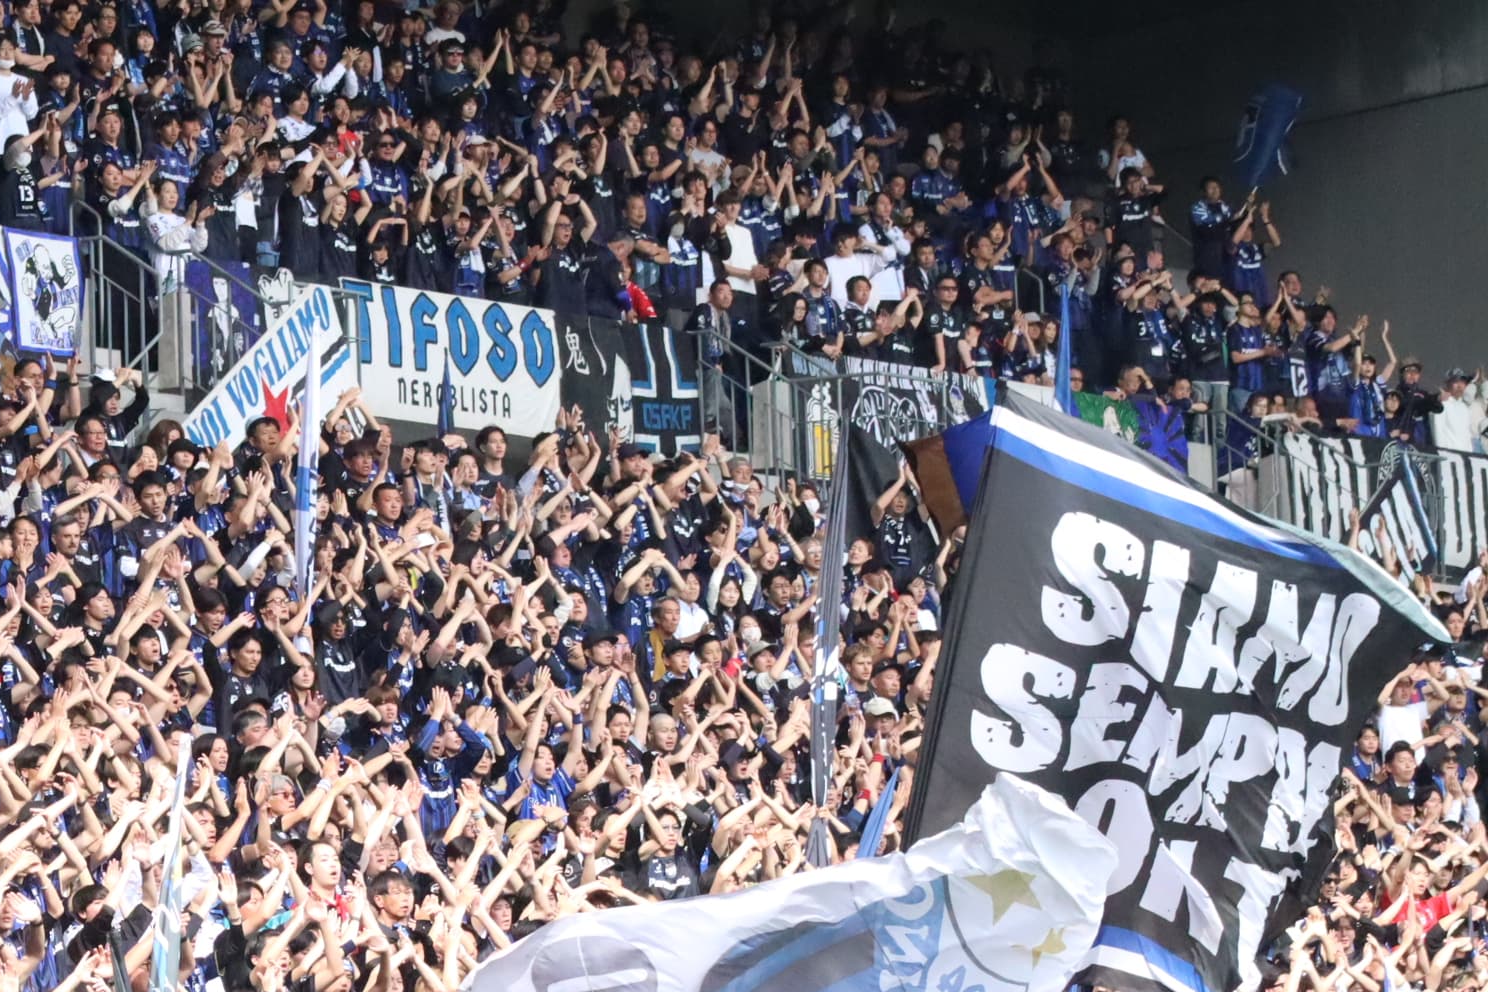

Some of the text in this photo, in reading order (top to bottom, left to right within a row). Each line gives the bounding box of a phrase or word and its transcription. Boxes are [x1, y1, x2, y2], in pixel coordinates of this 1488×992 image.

[341, 277, 555, 389] TIFOSO
[186, 396, 231, 449] NOI
[1040, 511, 1381, 727] SIAMO
[970, 642, 1342, 860] SEMPR
